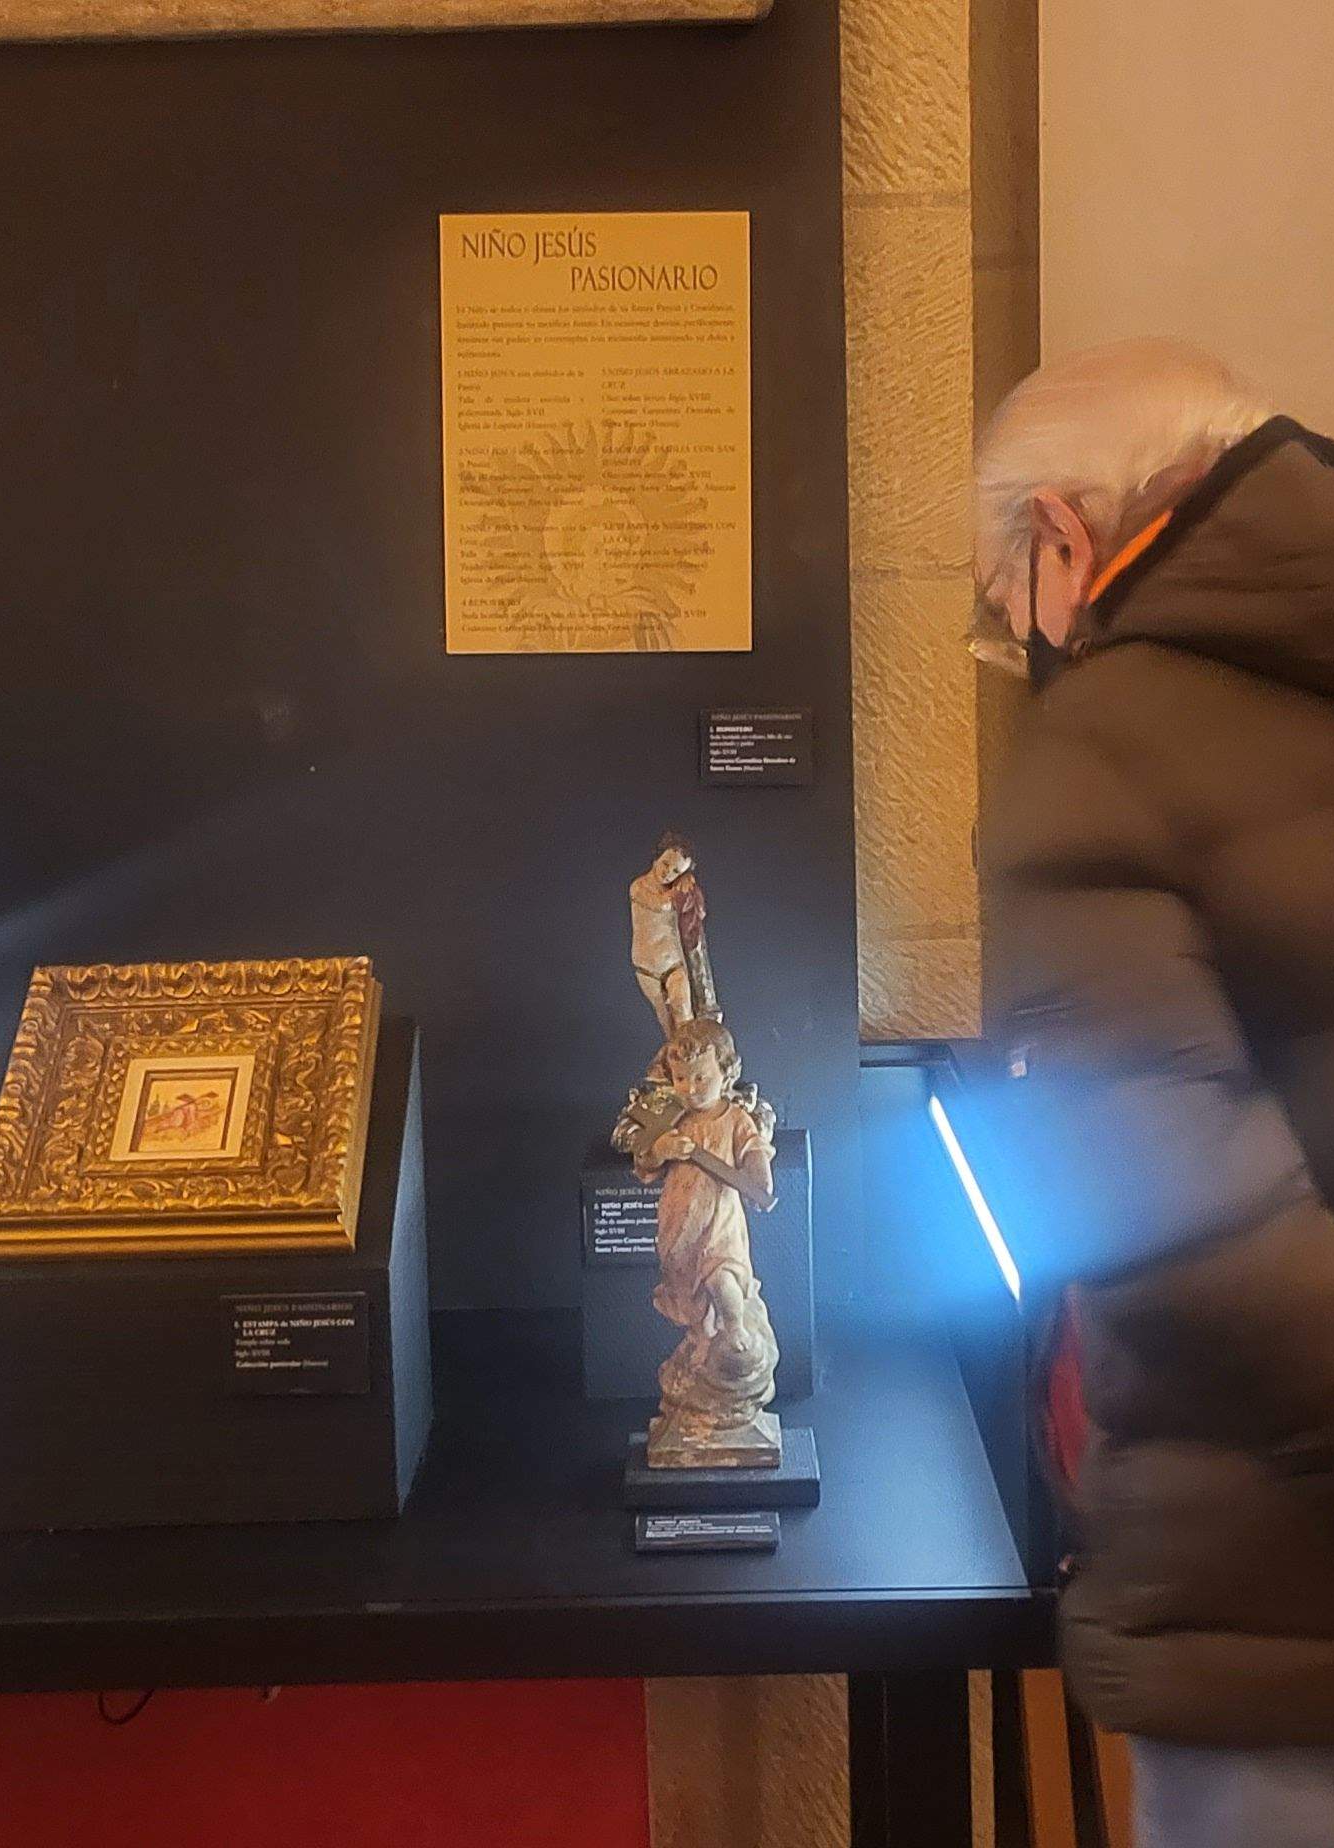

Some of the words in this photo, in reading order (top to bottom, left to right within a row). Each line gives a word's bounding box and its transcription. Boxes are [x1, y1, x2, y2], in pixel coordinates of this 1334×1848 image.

[462, 229, 525, 258] NIÑO
[535, 227, 596, 264] JESÚS
[571, 266, 717, 291] PASIONARIO
